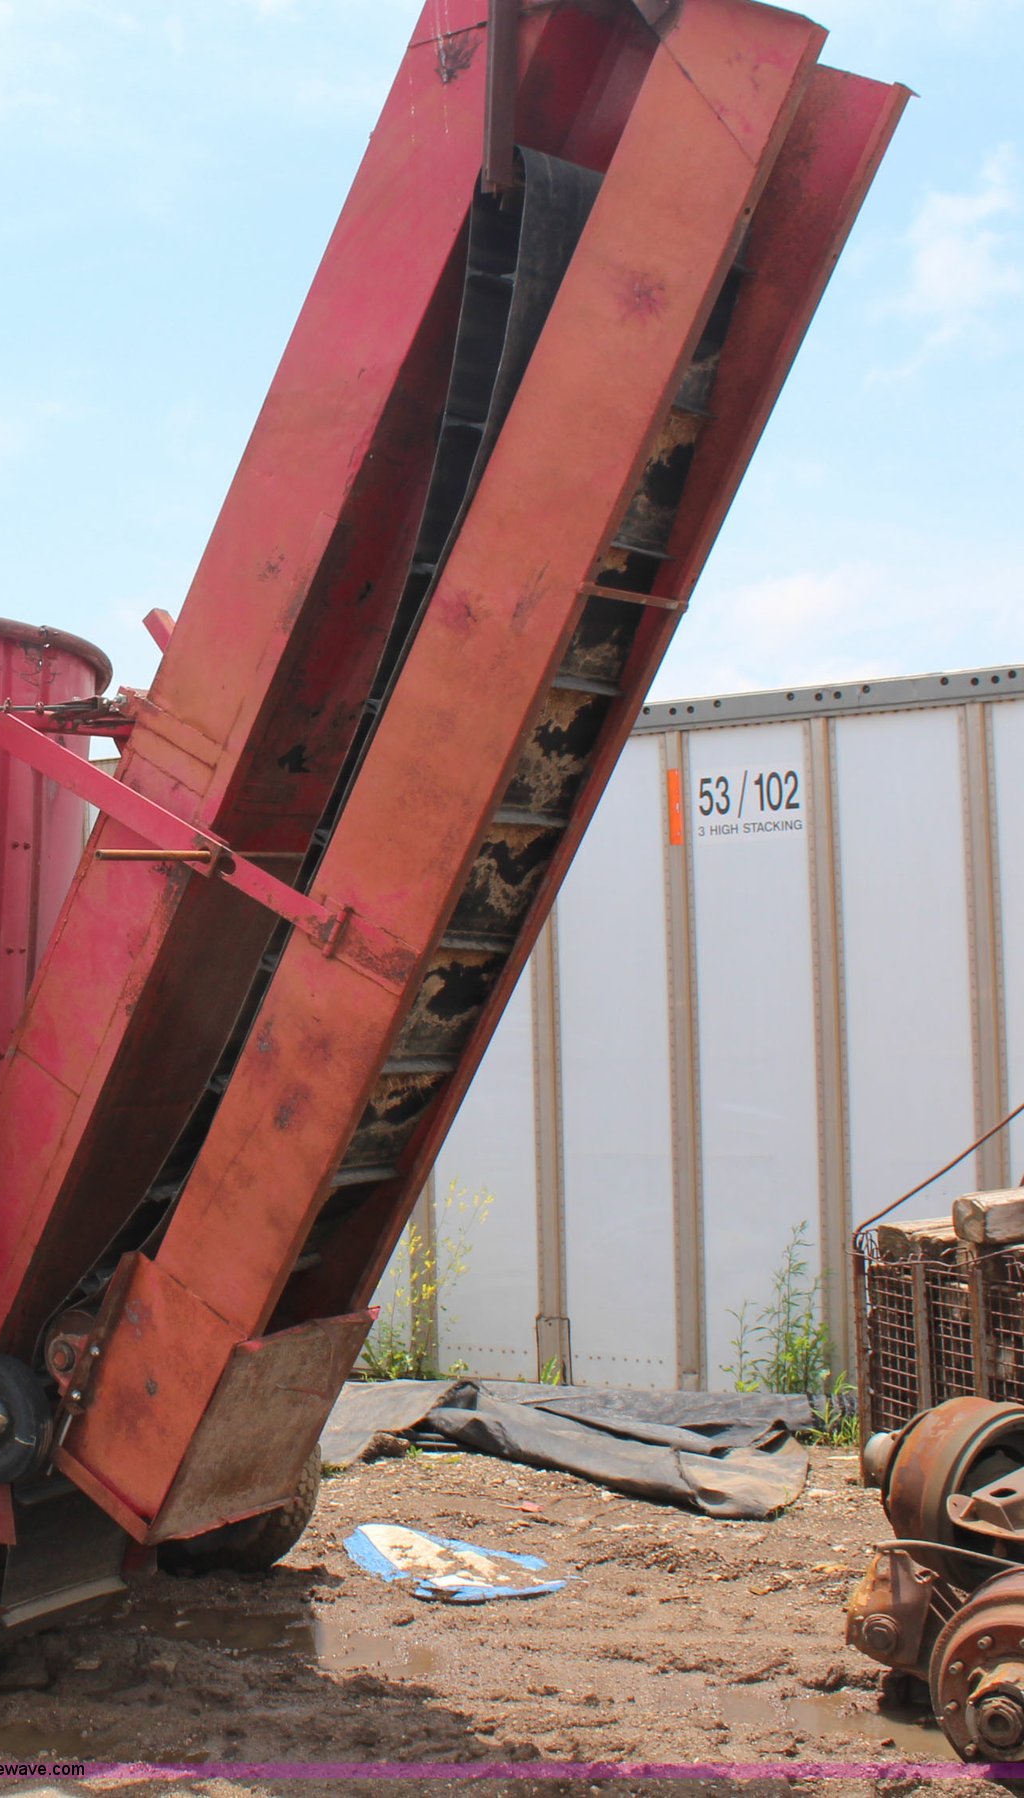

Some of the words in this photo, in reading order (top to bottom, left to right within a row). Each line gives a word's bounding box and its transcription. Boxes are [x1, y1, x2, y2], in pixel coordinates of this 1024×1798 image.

[698, 826, 706, 836] 3
[710, 823, 739, 835] HIGH
[742, 819, 803, 834] STACKING
